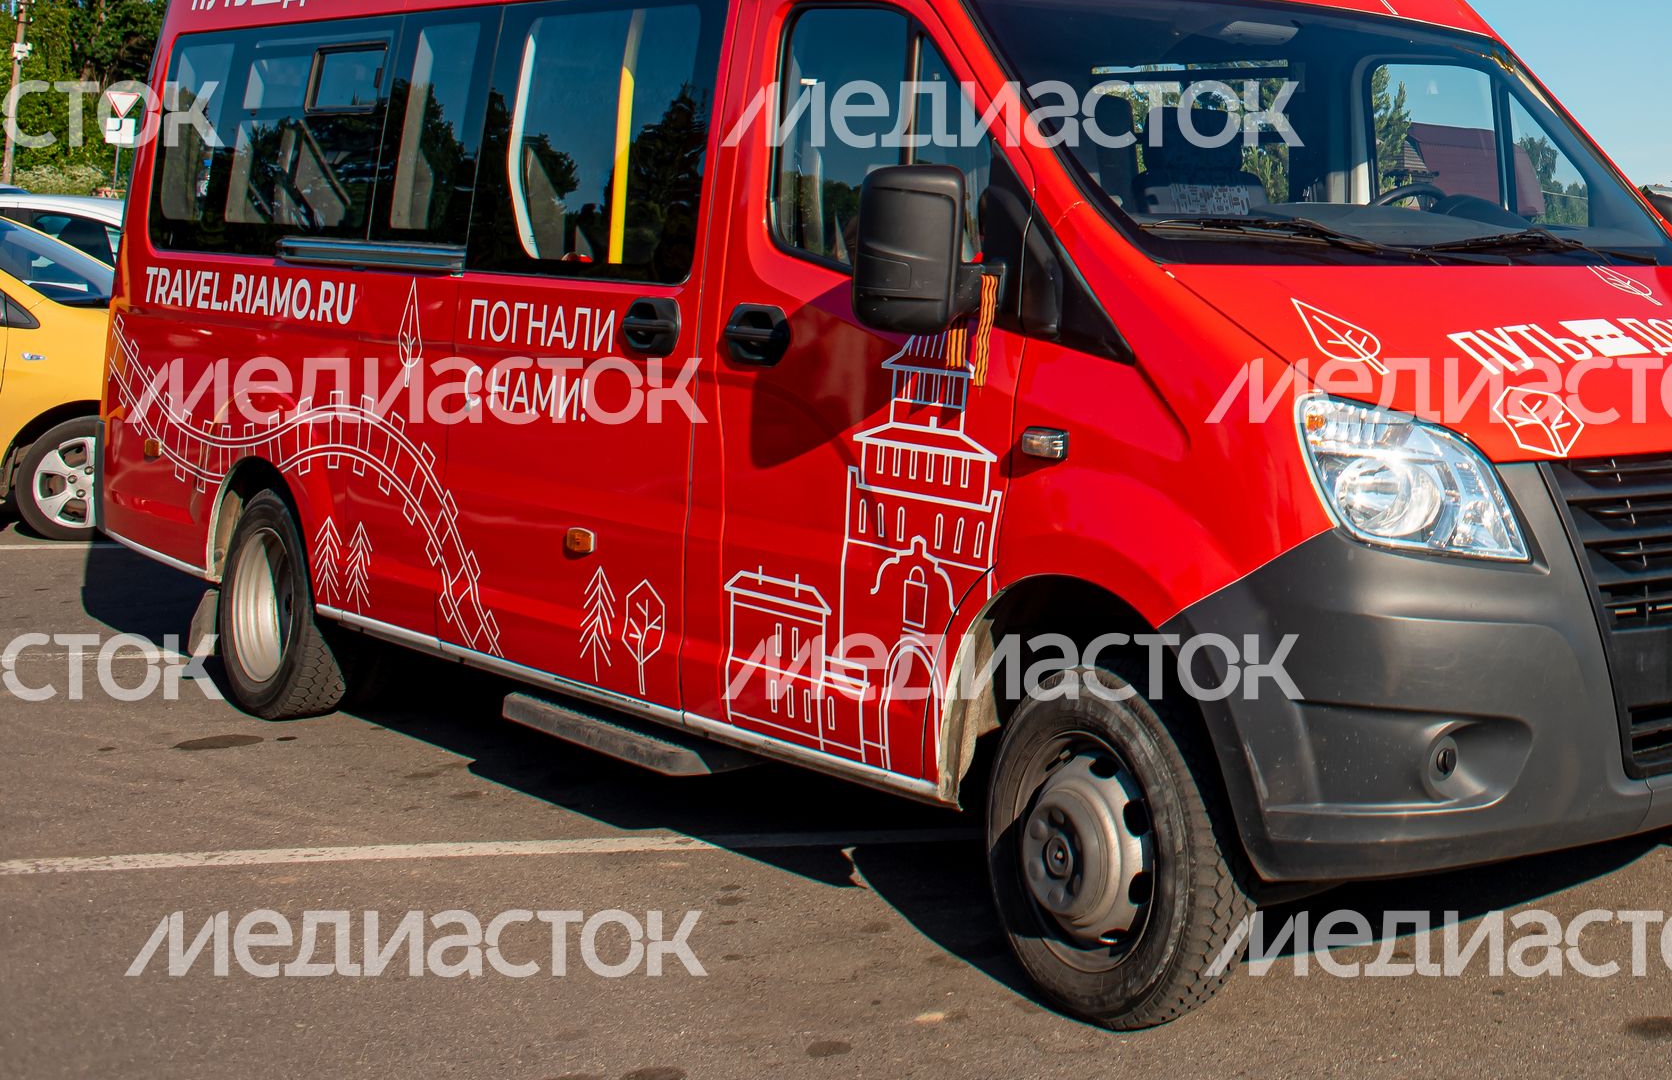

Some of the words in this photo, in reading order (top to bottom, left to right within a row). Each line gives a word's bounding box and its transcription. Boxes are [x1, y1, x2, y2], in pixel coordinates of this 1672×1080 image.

[145, 266, 356, 325] TRAVEL.RIAMO.RU
[467, 298, 616, 354] ПОГНАЛИ
[1447, 322, 1594, 376] ПУТЬ
[464, 365, 483, 407] С
[489, 367, 589, 422] НАМИ!
